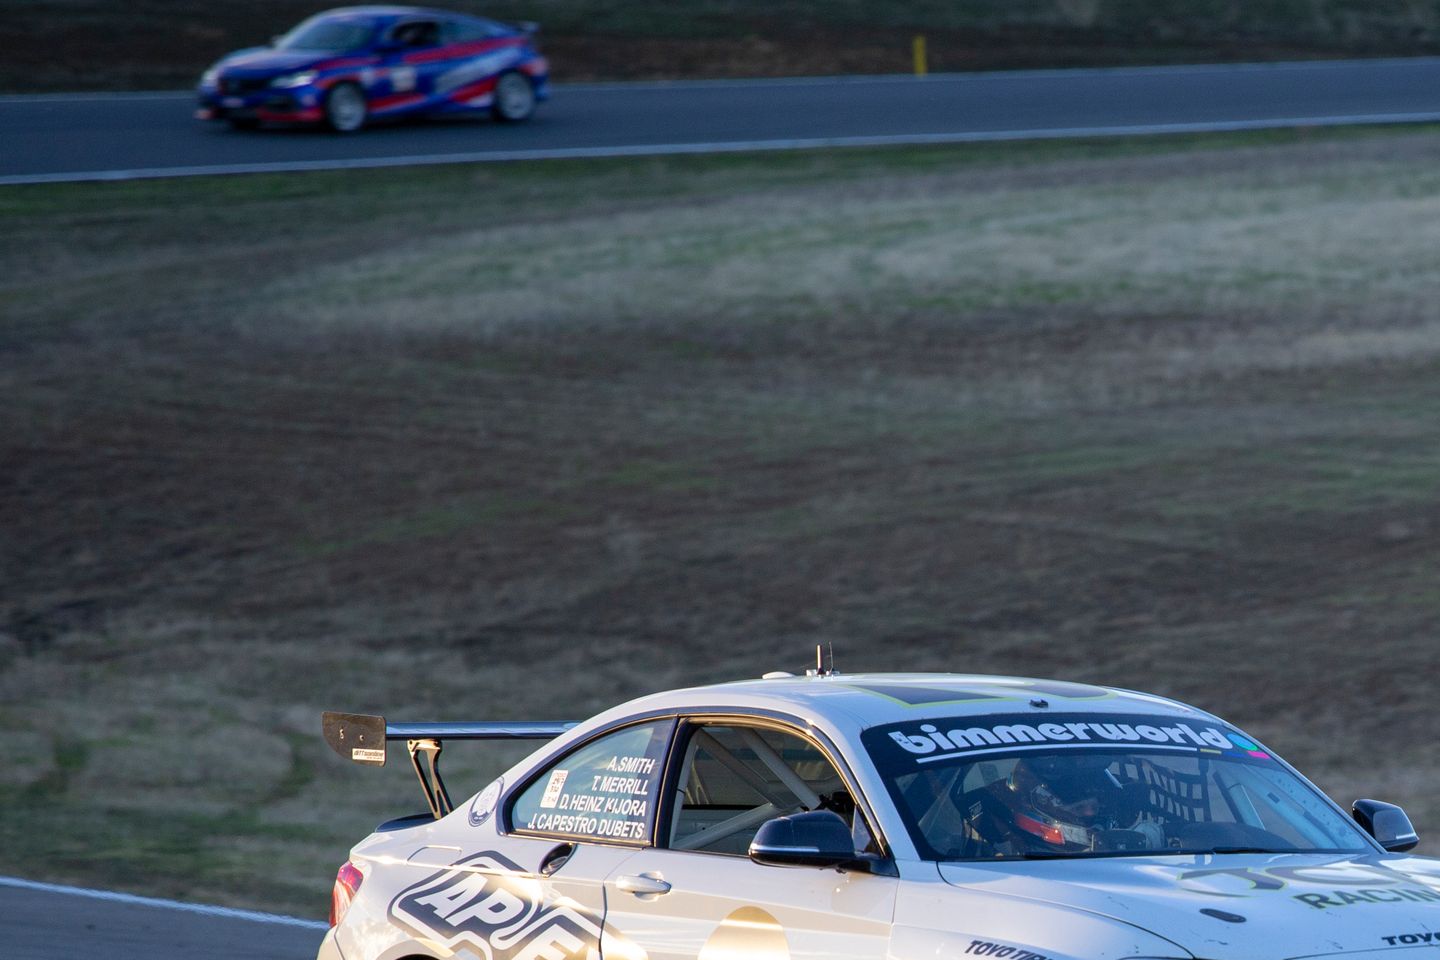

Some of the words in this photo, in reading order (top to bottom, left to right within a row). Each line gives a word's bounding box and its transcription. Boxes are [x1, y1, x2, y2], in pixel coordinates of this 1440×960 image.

[888, 722, 1233, 754] bimmerworld
[600, 776, 648, 795] MERRILL
[569, 794, 605, 813] HEINZ
[537, 813, 597, 834] CAPESTRO
[597, 818, 645, 838] DUBETS
[964, 939, 1017, 958] TOYO
